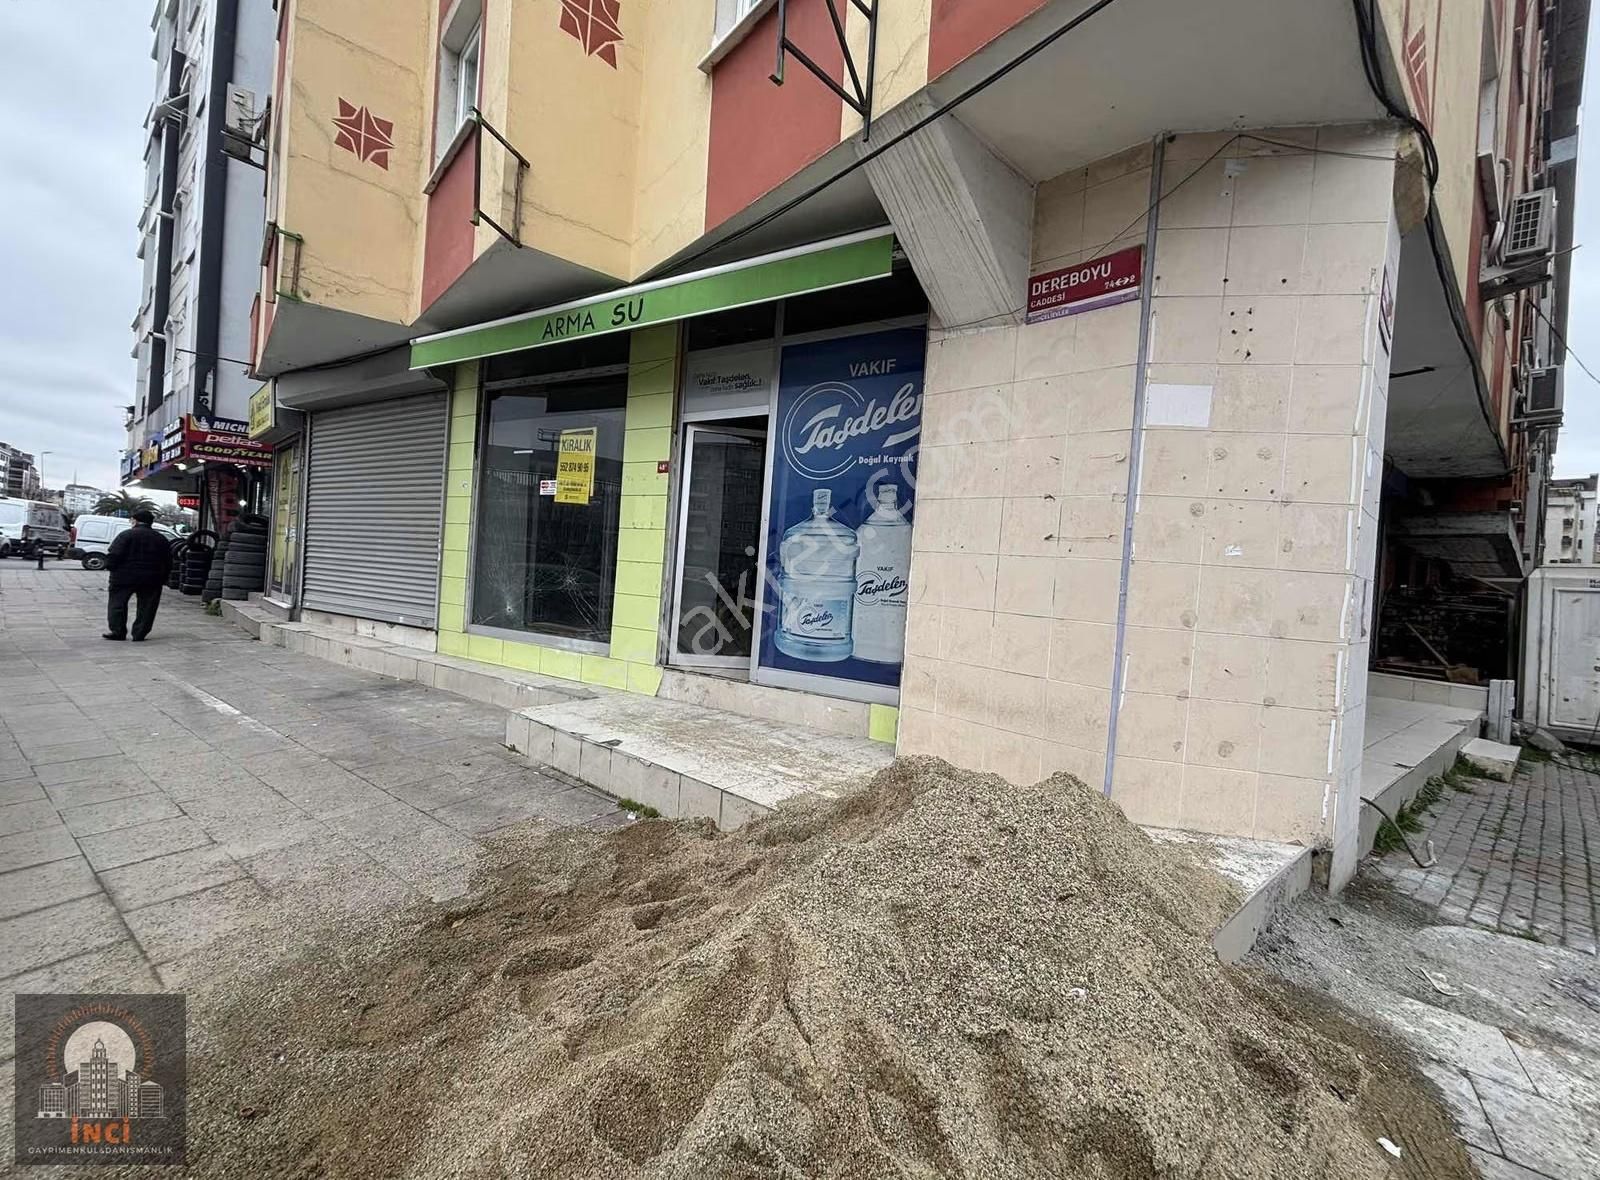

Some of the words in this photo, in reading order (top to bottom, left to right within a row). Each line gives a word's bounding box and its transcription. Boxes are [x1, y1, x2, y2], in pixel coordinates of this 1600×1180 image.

[1031, 261, 1111, 296] DEREBOYU
[1129, 274, 1136, 283] 2
[1030, 292, 1066, 308] CADDESİ
[542, 310, 596, 340] ARMA
[611, 297, 644, 326] SU
[849, 358, 897, 377] VAKIF
[206, 434, 263, 448] petlas
[193, 444, 273, 458] GOODYEAR
[858, 454, 881, 466] Doğal
[883, 453, 914, 465] Kaynak
[857, 576, 908, 597] Taşdelen
